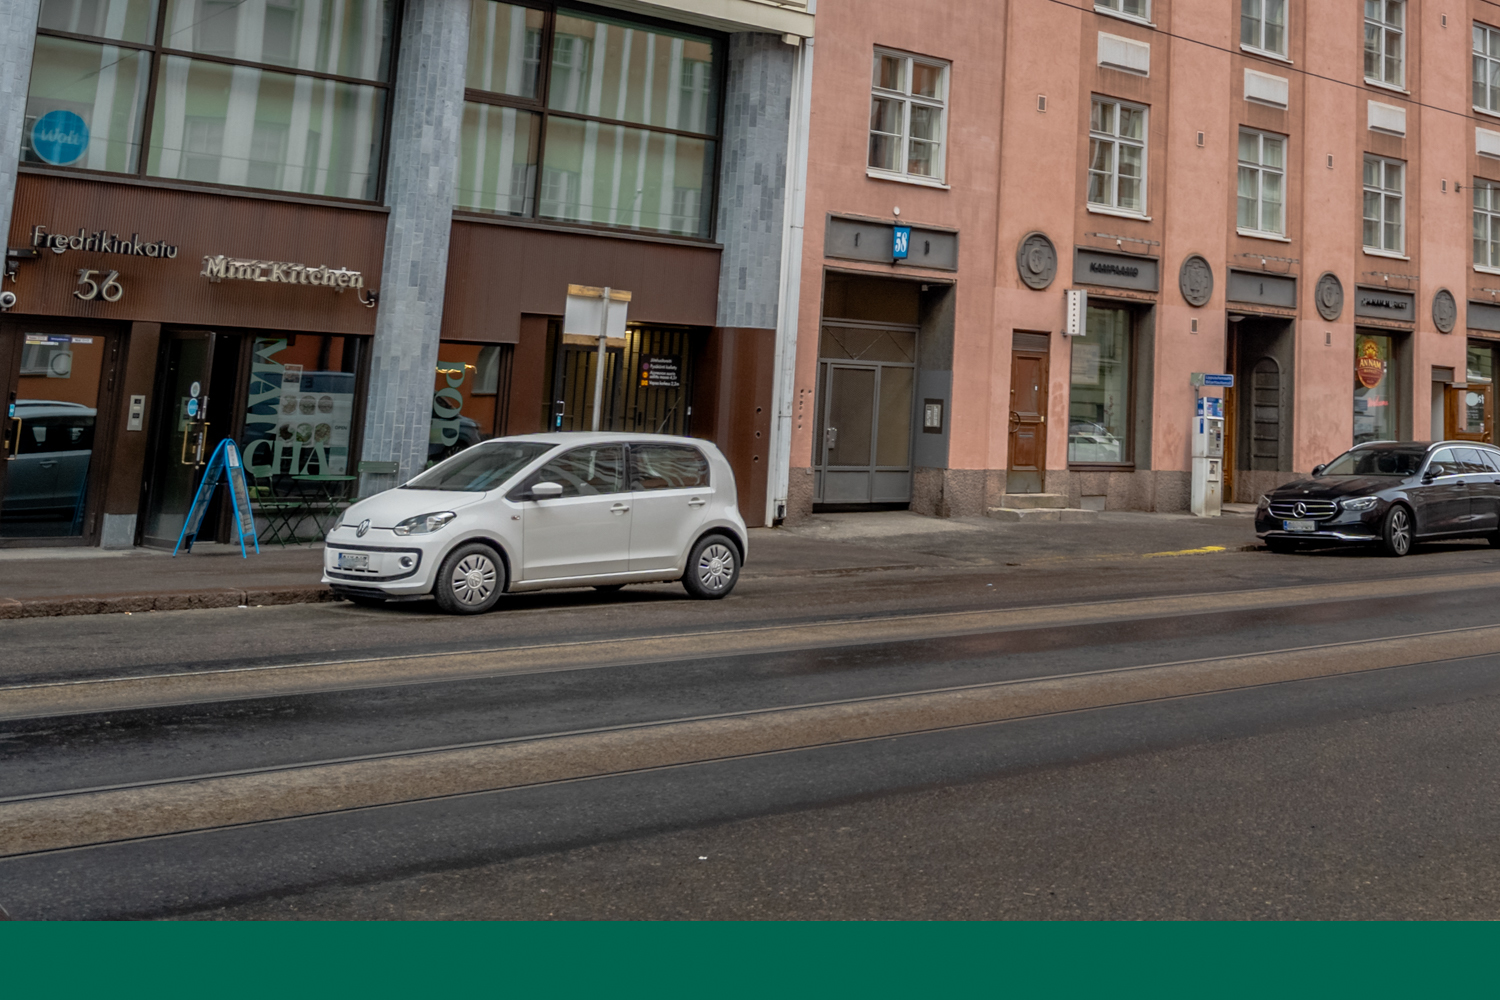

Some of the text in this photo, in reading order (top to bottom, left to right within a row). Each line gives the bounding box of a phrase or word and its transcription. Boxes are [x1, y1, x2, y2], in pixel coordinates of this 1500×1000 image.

[41, 128, 80, 145] Wolt
[32, 225, 178, 258] Fredrikinkatu
[895, 232, 908, 252] 58
[73, 269, 123, 302] 56
[201, 255, 364, 288] Mini Kitchen
[243, 439, 331, 475] CHA
